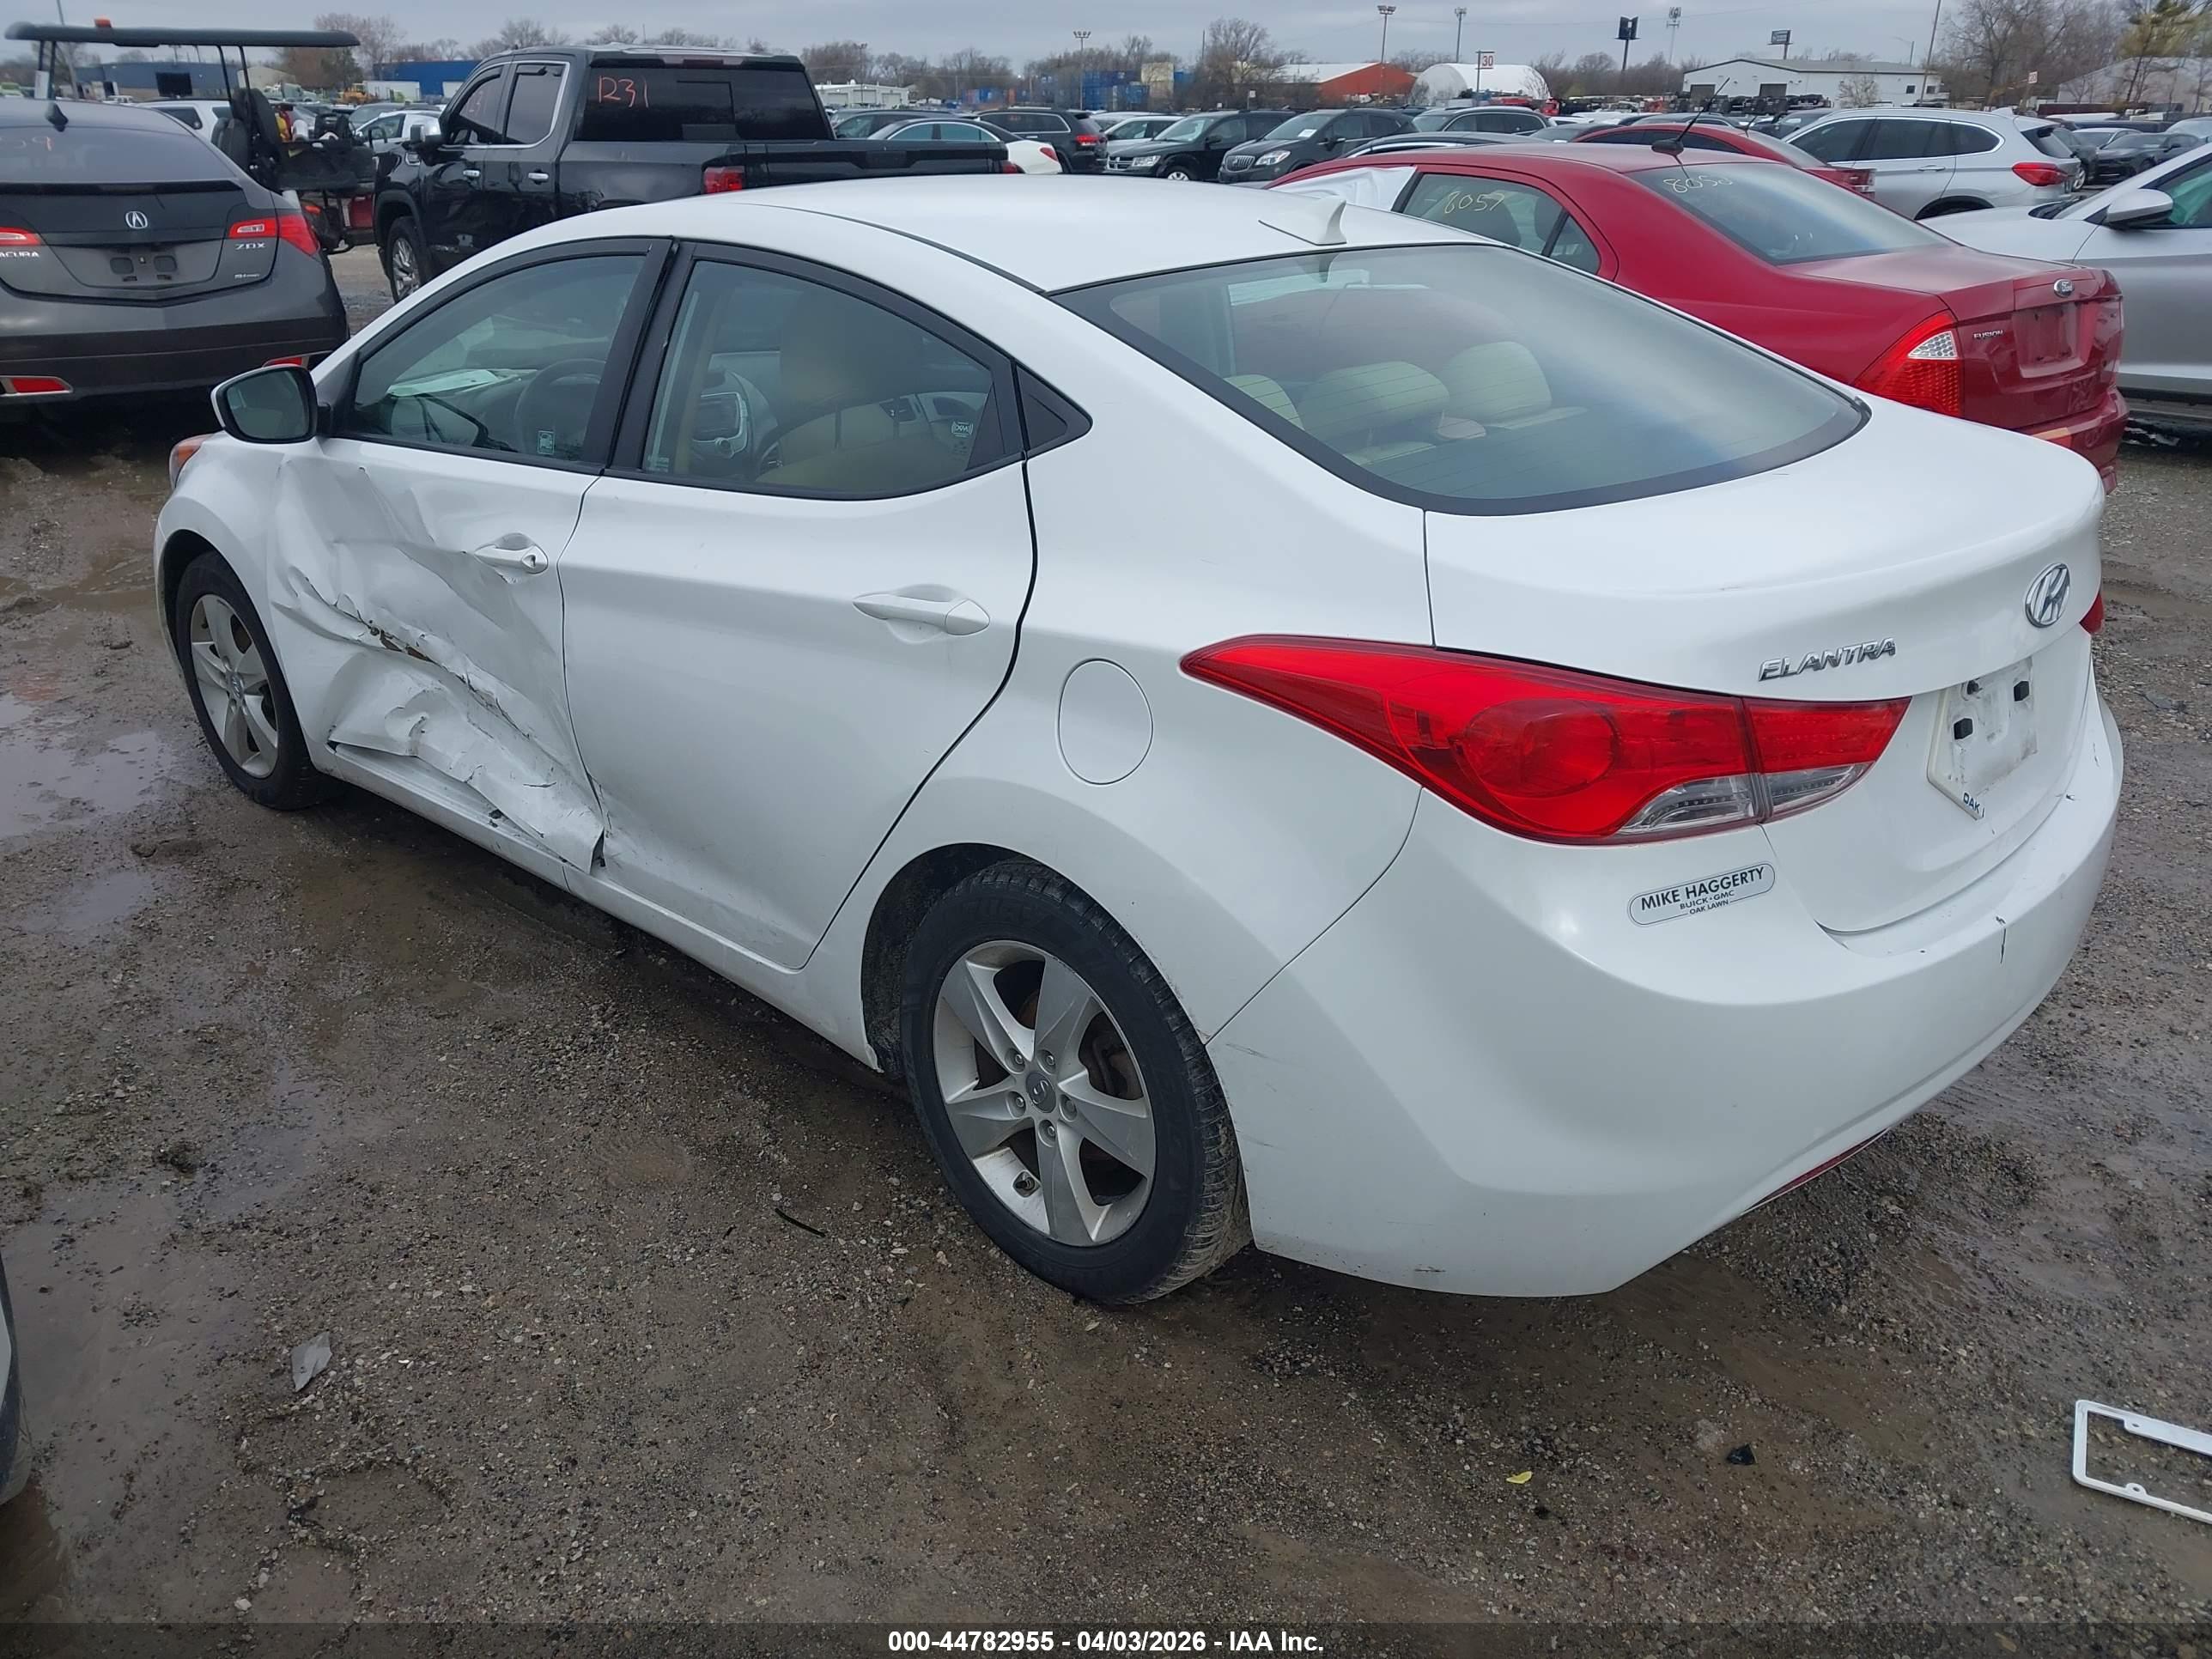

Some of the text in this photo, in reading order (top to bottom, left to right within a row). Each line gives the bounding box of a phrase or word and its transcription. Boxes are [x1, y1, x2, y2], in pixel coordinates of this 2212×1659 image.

[1482, 55, 1494, 67] 30
[599, 76, 649, 109] 1231
[1444, 191, 1505, 214] 8057
[235, 242, 266, 251] ZDX
[1973, 330, 2004, 339] FUSION
[1759, 637, 1896, 682] ELANTRA
[1963, 792, 1980, 814] OAK
[1641, 866, 1765, 911] MIKE HAGGERTY
[1689, 899, 1729, 915] OAK LAWN
